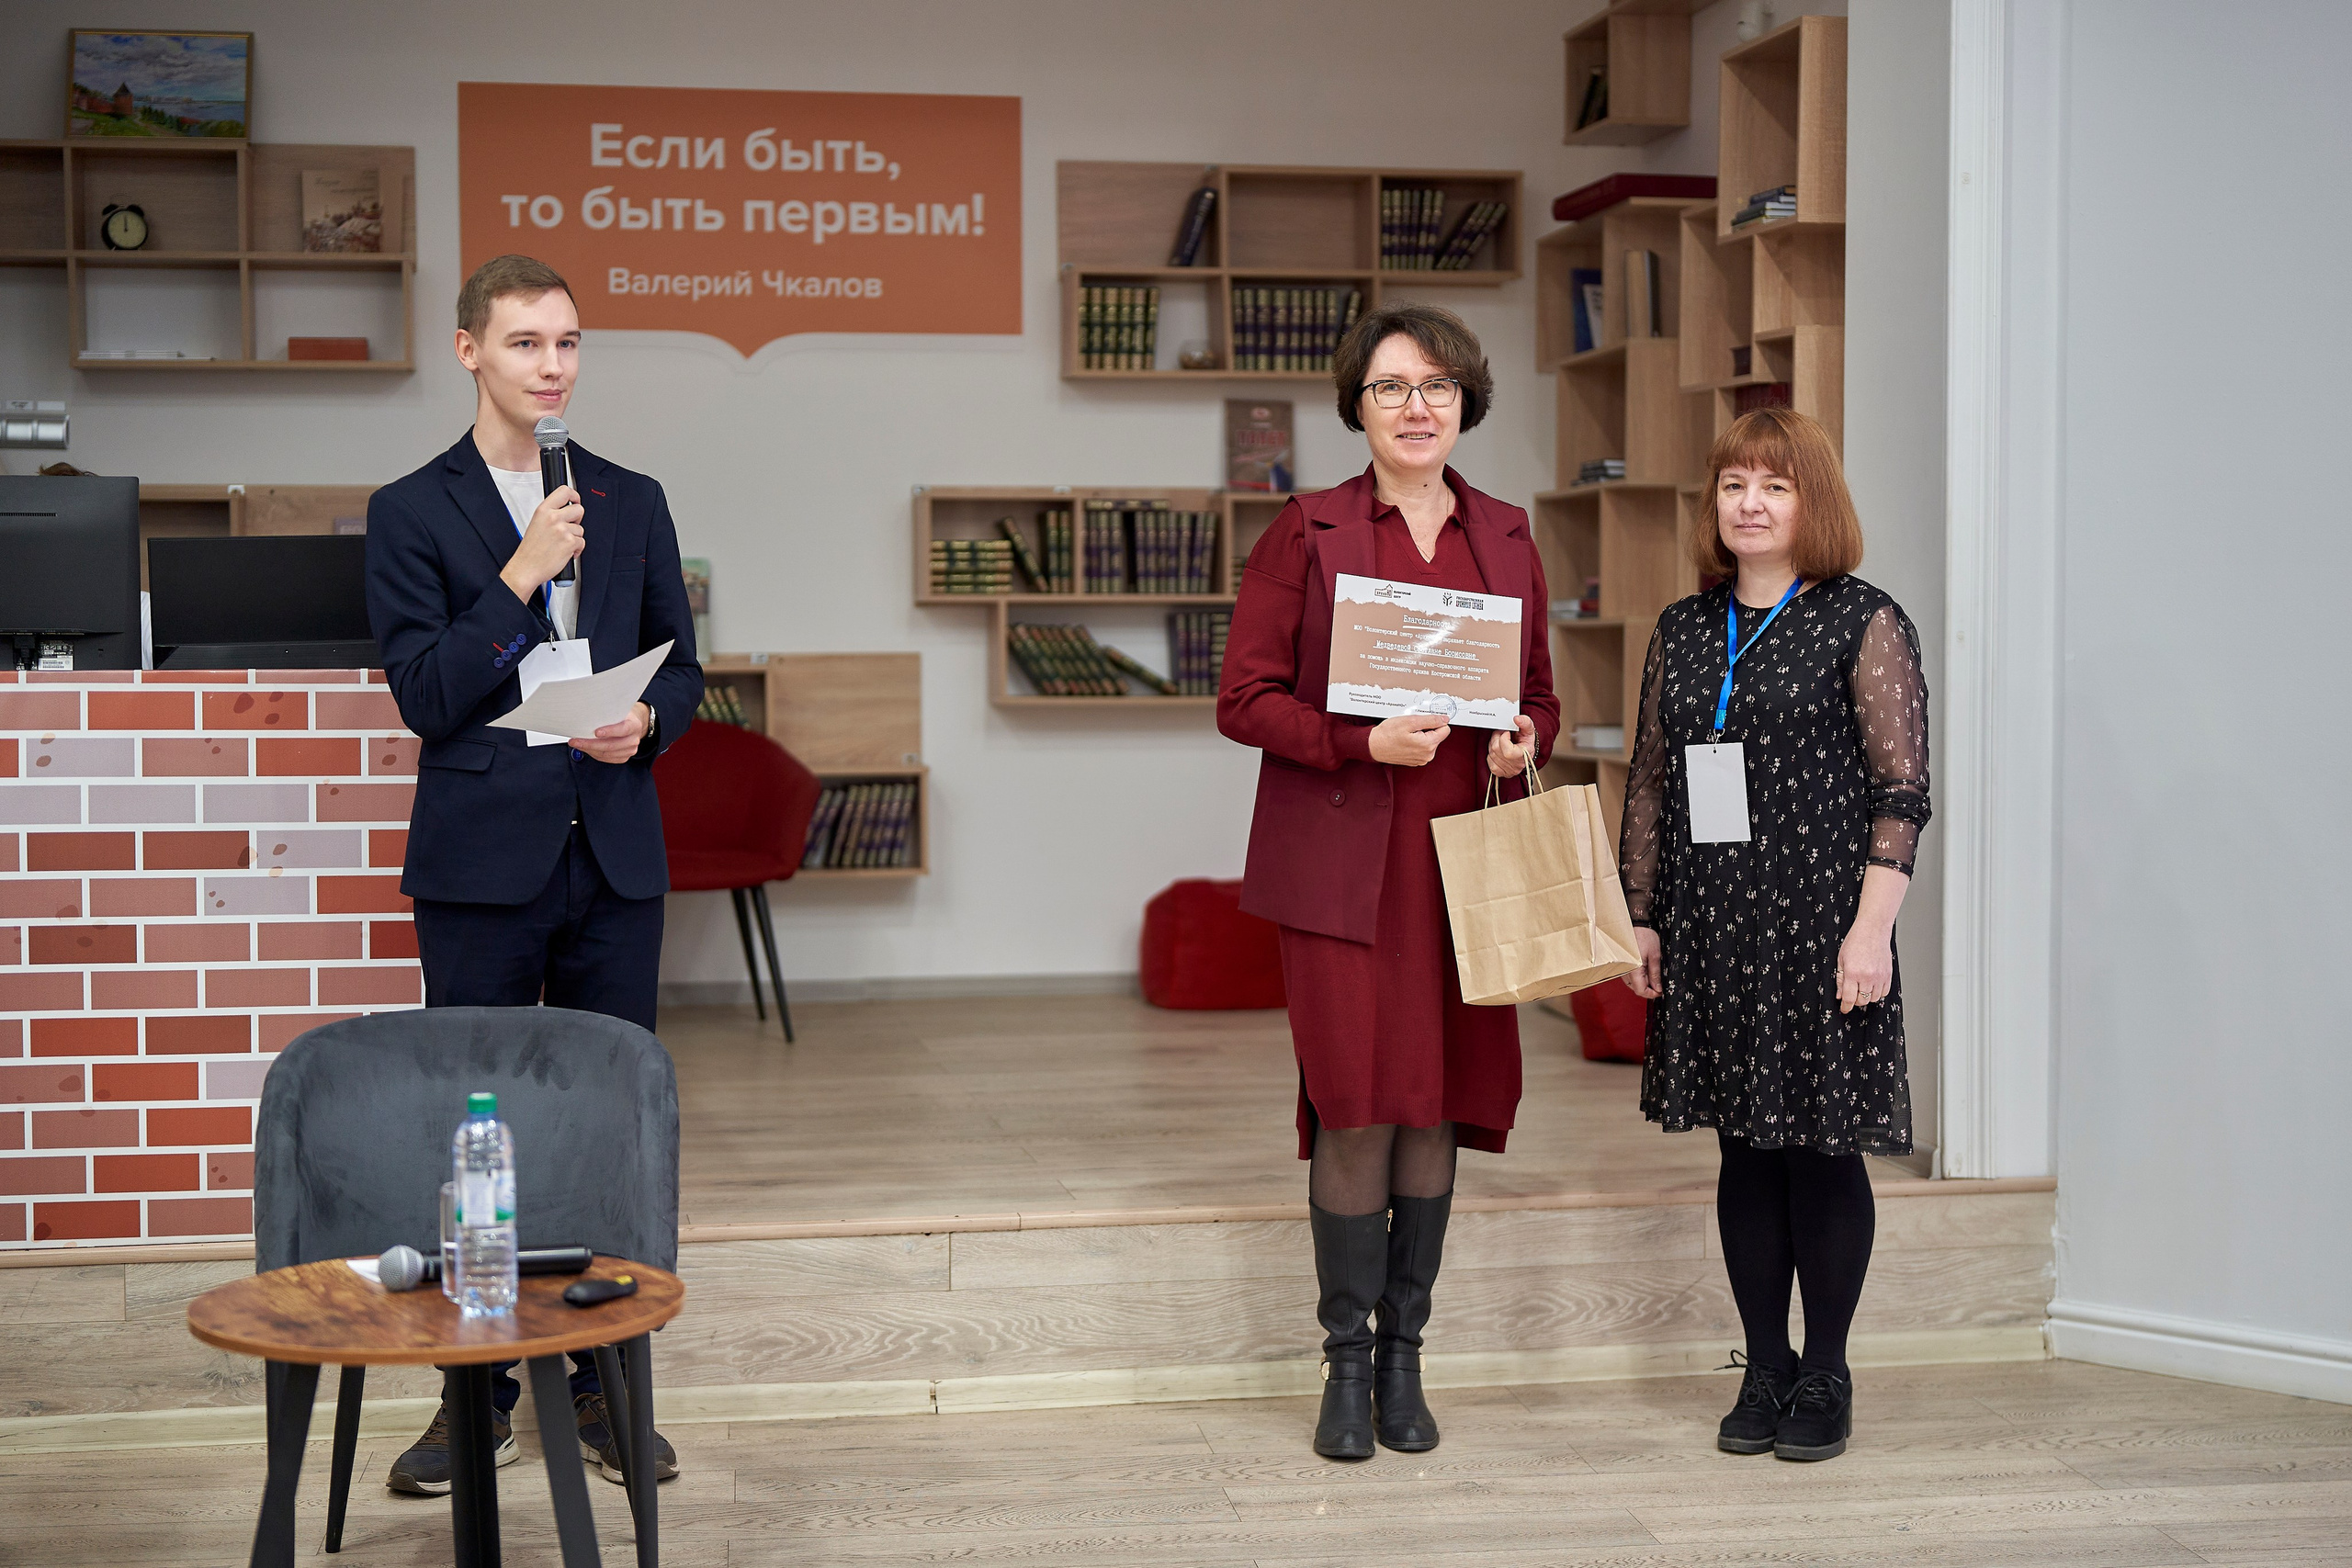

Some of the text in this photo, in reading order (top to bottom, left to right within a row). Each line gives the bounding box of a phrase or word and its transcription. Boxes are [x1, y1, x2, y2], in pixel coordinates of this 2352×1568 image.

[591, 122, 900, 180] Если быть,
[501, 186, 985, 244] то быть первым!
[608, 267, 883, 300] Валерий Чкалов
[1376, 640, 1410, 651] Медведевой
[1444, 649, 1476, 659] Борисовне
[1399, 631, 1413, 639] центр
[1465, 638, 1500, 649] благодарность
[1369, 662, 1411, 673] Государственного
[1430, 670, 1460, 679] Костромской
[1462, 673, 1481, 682] области
[1419, 660, 1465, 671] научно-справочного
